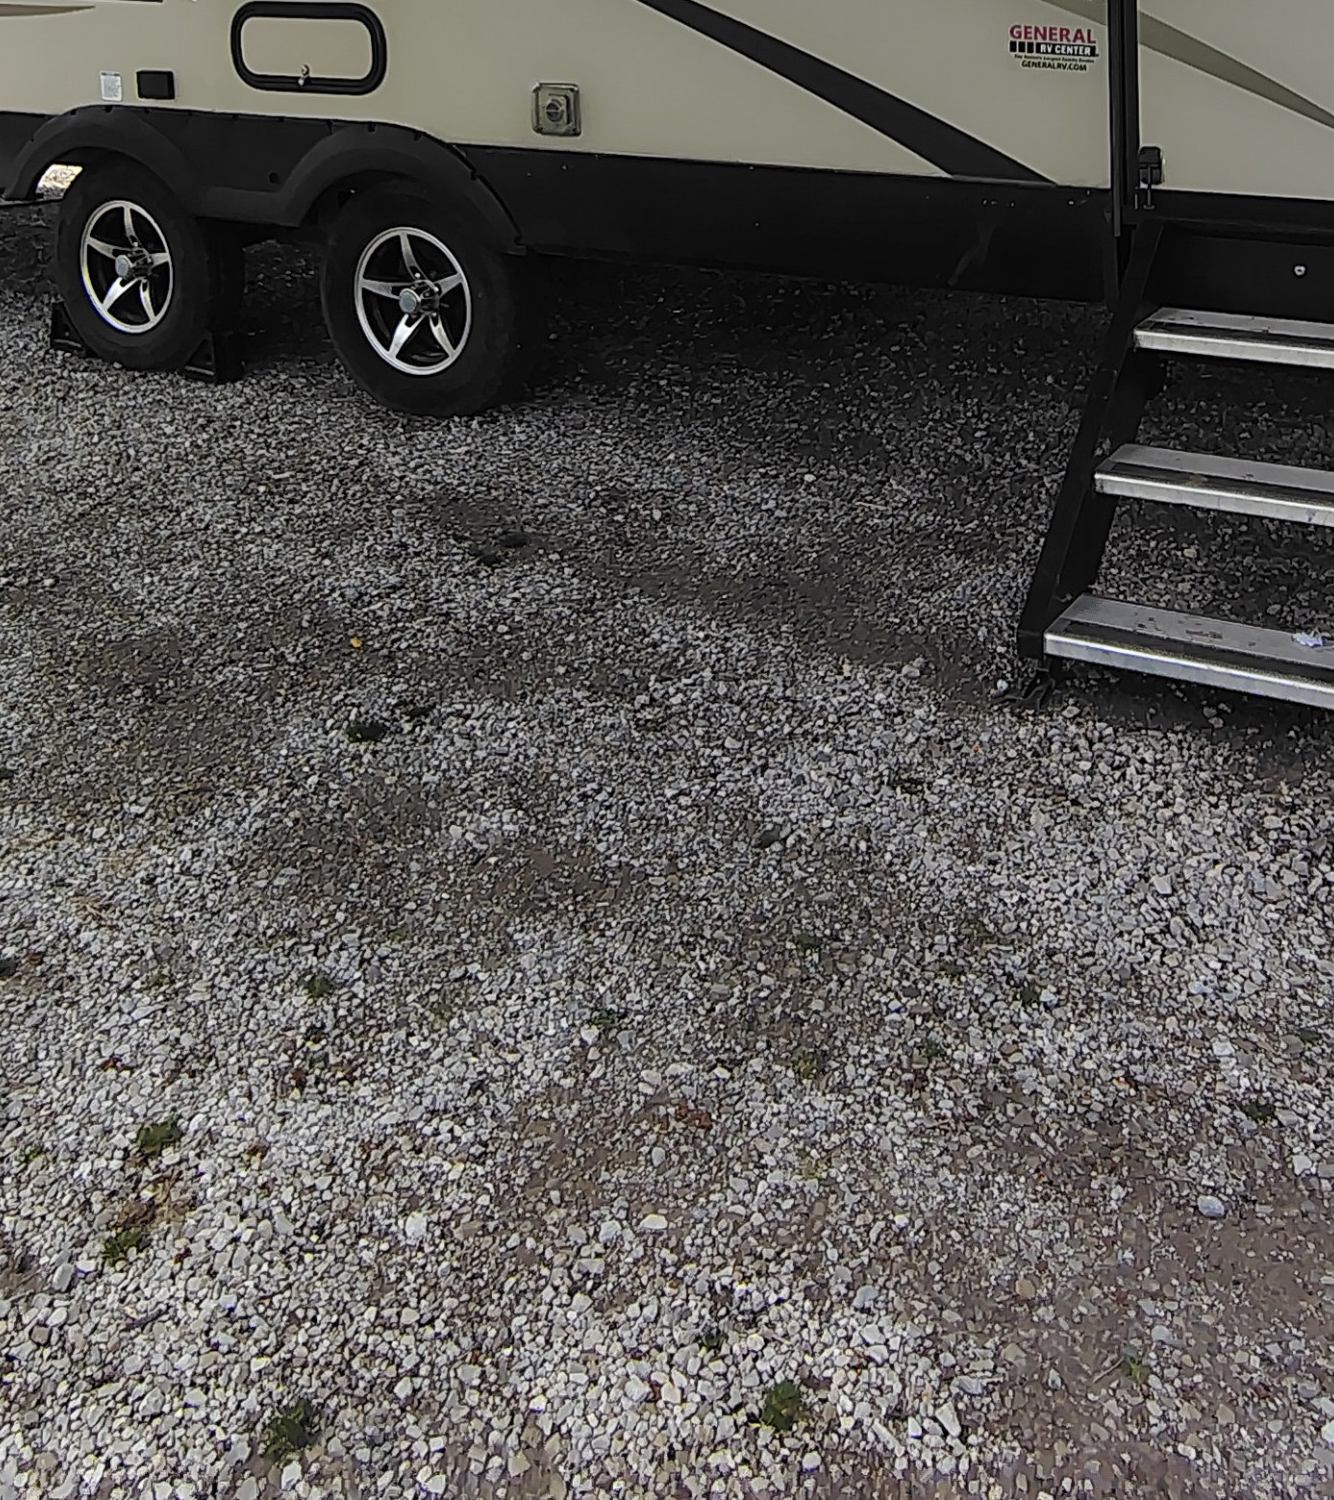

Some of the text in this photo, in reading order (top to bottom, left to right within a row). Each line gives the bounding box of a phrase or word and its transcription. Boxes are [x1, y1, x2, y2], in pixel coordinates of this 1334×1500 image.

[1009, 25, 1097, 44] GENERAL
[1040, 44, 1091, 56] RV CENTER
[1021, 60, 1088, 72] GENERALRV.COM
